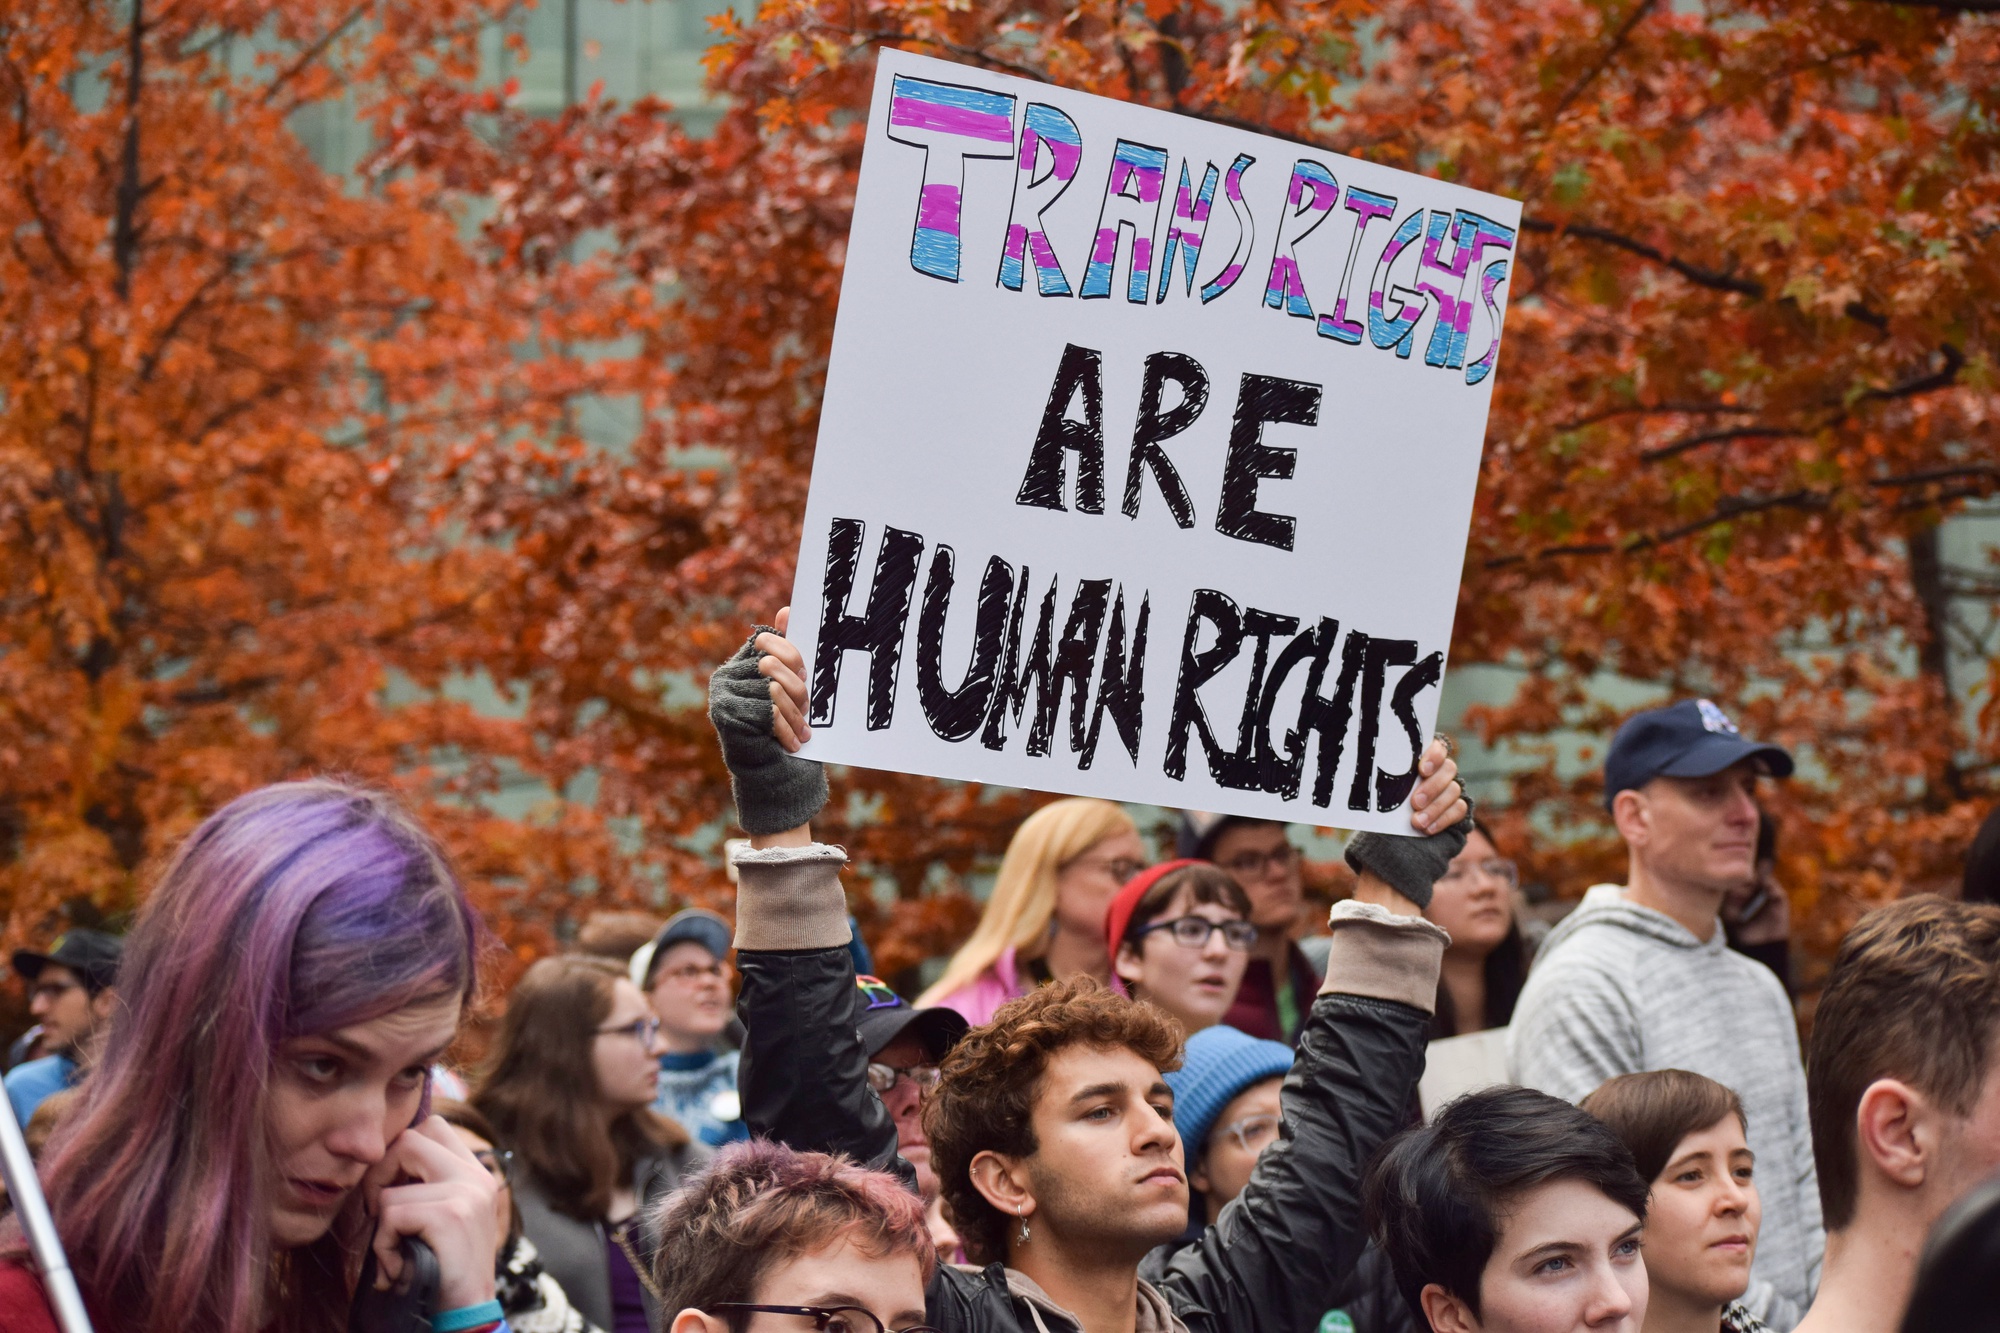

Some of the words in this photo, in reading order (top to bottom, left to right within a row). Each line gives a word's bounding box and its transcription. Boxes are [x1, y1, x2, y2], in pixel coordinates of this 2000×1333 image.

[887, 74, 1255, 305] TRANS
[1263, 160, 1516, 385] RIGHTS
[1015, 343, 1323, 551] ARE
[810, 518, 1149, 770] HUMAN
[1163, 589, 1443, 812] RIGHTS
